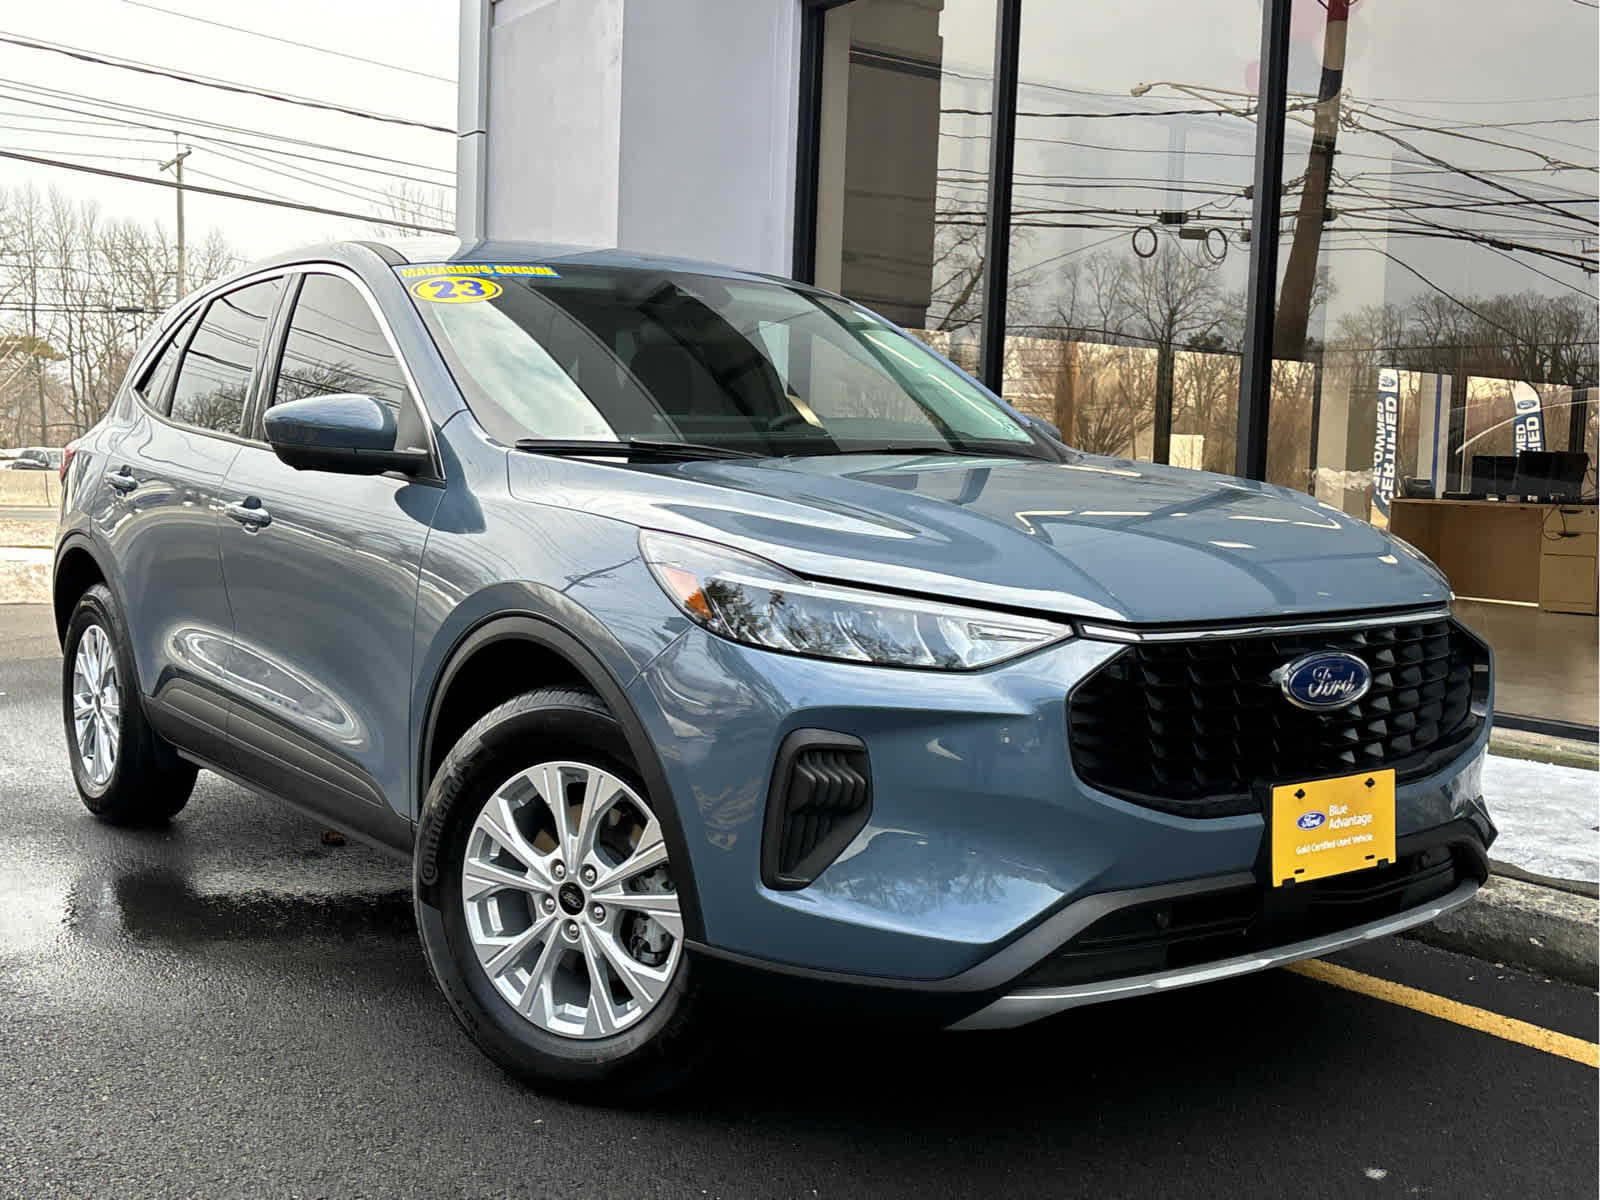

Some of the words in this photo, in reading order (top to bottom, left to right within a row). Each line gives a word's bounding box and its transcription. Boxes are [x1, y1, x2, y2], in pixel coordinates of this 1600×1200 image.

[402, 265, 493, 276] MANAGER'S
[494, 265, 558, 276] SPECIAL
[429, 279, 486, 298] 23
[1307, 665, 1357, 698] Ford
[1328, 805, 1348, 816] Blue
[1301, 813, 1322, 828] Ford
[1328, 814, 1373, 829] Advantage
[1295, 844, 1311, 855] Gold
[1311, 840, 1336, 852] Certified
[1336, 836, 1351, 847] Used
[1352, 834, 1373, 843] Vehicle
